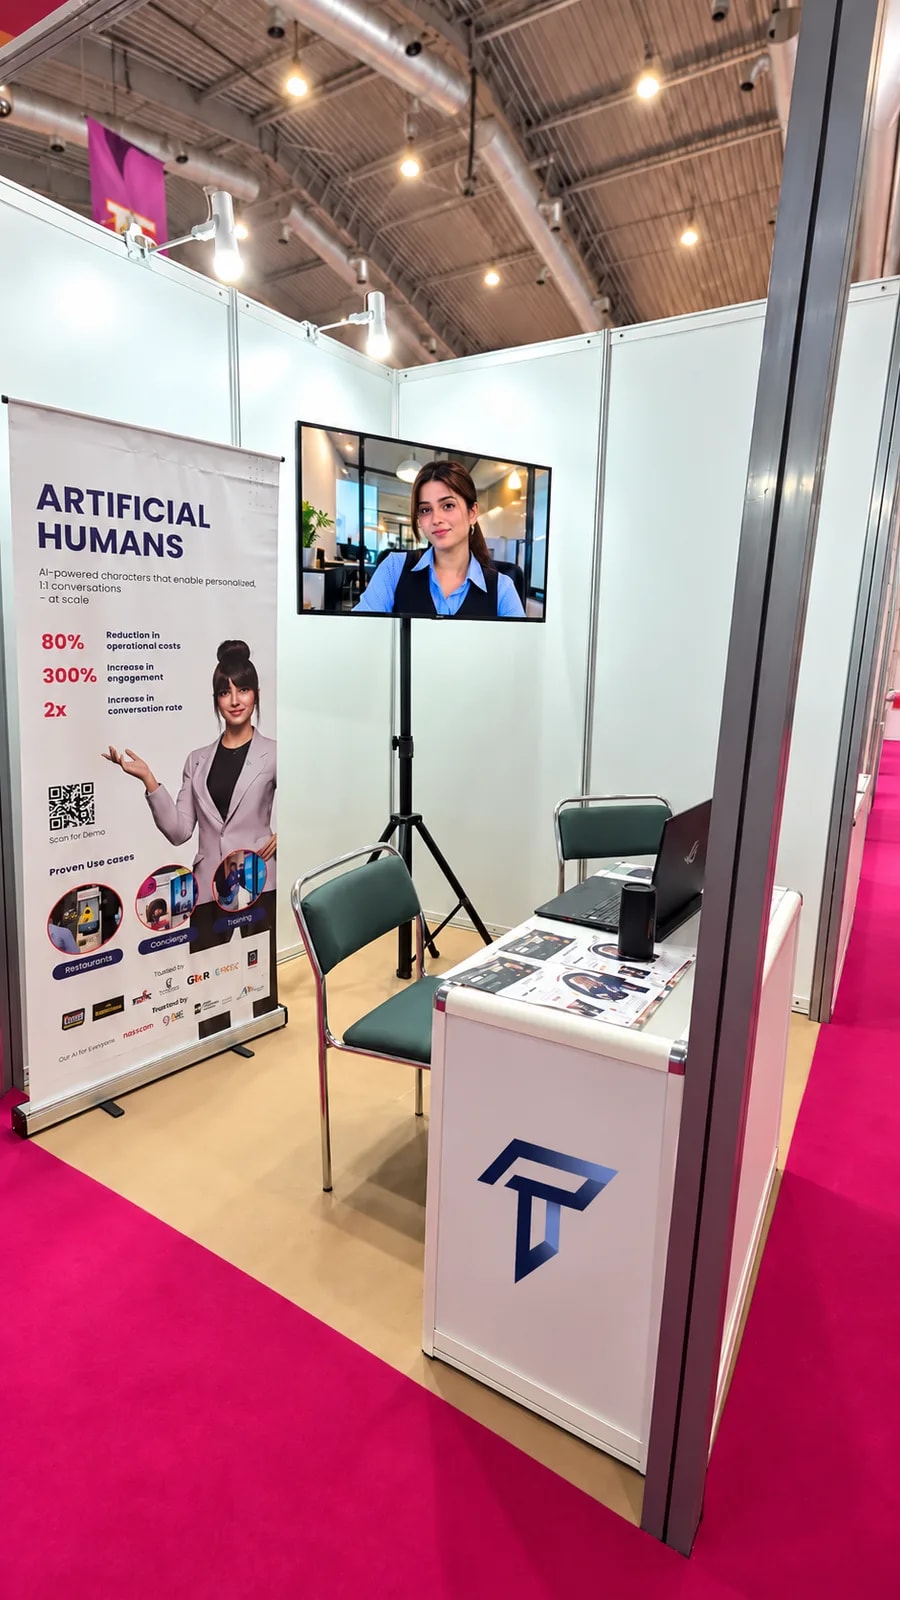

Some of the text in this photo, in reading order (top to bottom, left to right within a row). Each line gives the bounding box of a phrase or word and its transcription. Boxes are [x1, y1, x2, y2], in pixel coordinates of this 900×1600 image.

[37, 484, 211, 529] ARTIFICIAL
[38, 522, 184, 559] HUMANS
[39, 568, 256, 588] AI-powered characters that enable personalized,
[39, 581, 122, 593] 1:1 conversations
[48, 595, 60, 605] at
[62, 595, 90, 605] scale
[41, 633, 85, 650] 80%
[106, 631, 160, 639] Reduction in
[106, 642, 181, 651] operational costs
[107, 663, 154, 672] Increase in
[42, 667, 97, 684] 300%
[107, 674, 164, 684] engagement
[107, 694, 155, 704] Increase in
[44, 701, 67, 718] 2x
[107, 703, 183, 715] conversation rate
[49, 829, 106, 844] Scan for Demo
[49, 853, 135, 876] Proven Use cases
[227, 913, 252, 928] Training
[150, 933, 188, 949] Concierge
[65, 955, 113, 974] Restaurants
[123, 1023, 154, 1039] nasscom
